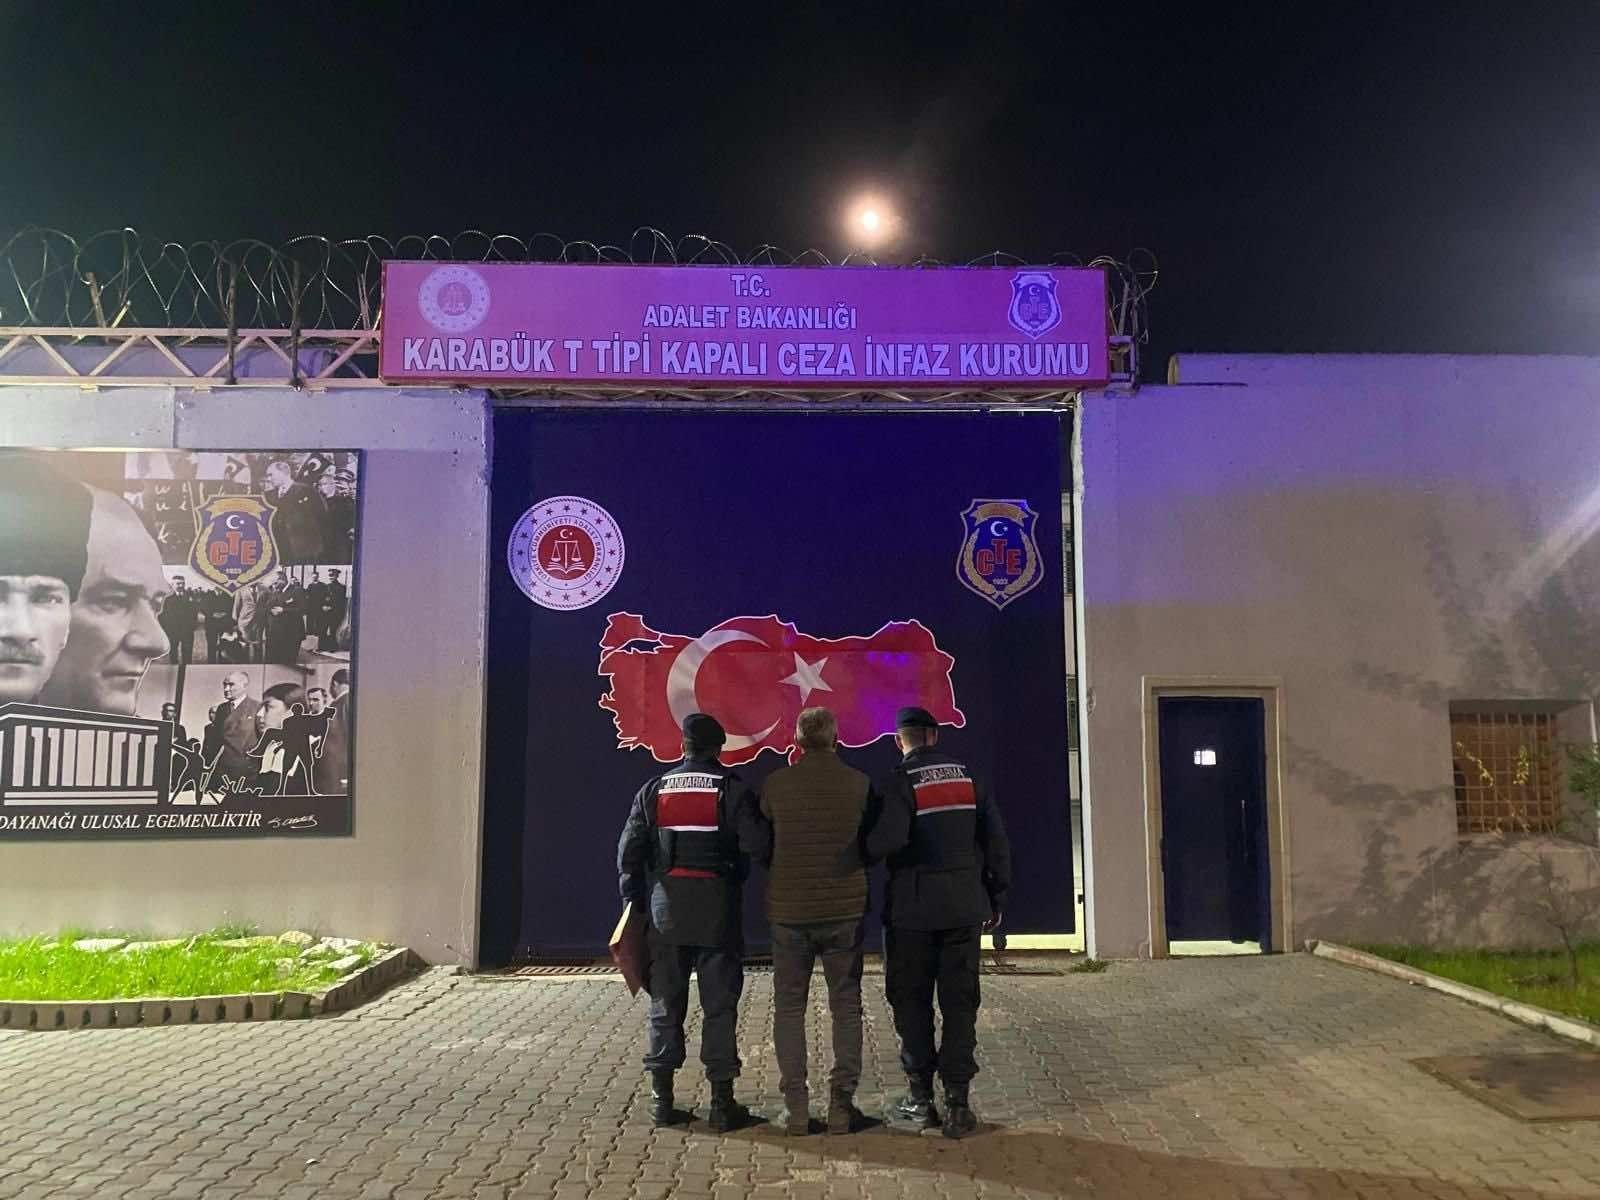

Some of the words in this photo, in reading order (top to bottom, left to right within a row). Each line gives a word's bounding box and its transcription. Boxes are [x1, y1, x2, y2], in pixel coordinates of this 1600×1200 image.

[731, 274, 770, 297] T.C.
[643, 305, 729, 328] ADALET
[736, 303, 857, 329] BAKANLIĞI
[402, 331, 556, 373] KARABÜK
[563, 340, 583, 373] T
[592, 331, 651, 374] TİPİ
[661, 341, 767, 375] KAPALI
[777, 343, 856, 376] CEZA
[865, 336, 952, 377] İNFAZ
[959, 343, 1090, 377] KURUMU
[210, 531, 256, 566] CTE
[976, 539, 1022, 576] CTE
[663, 777, 713, 790] JANDARMA
[81, 814, 140, 829] ULUSAL
[145, 810, 262, 828] EGEMENLİKTİR
